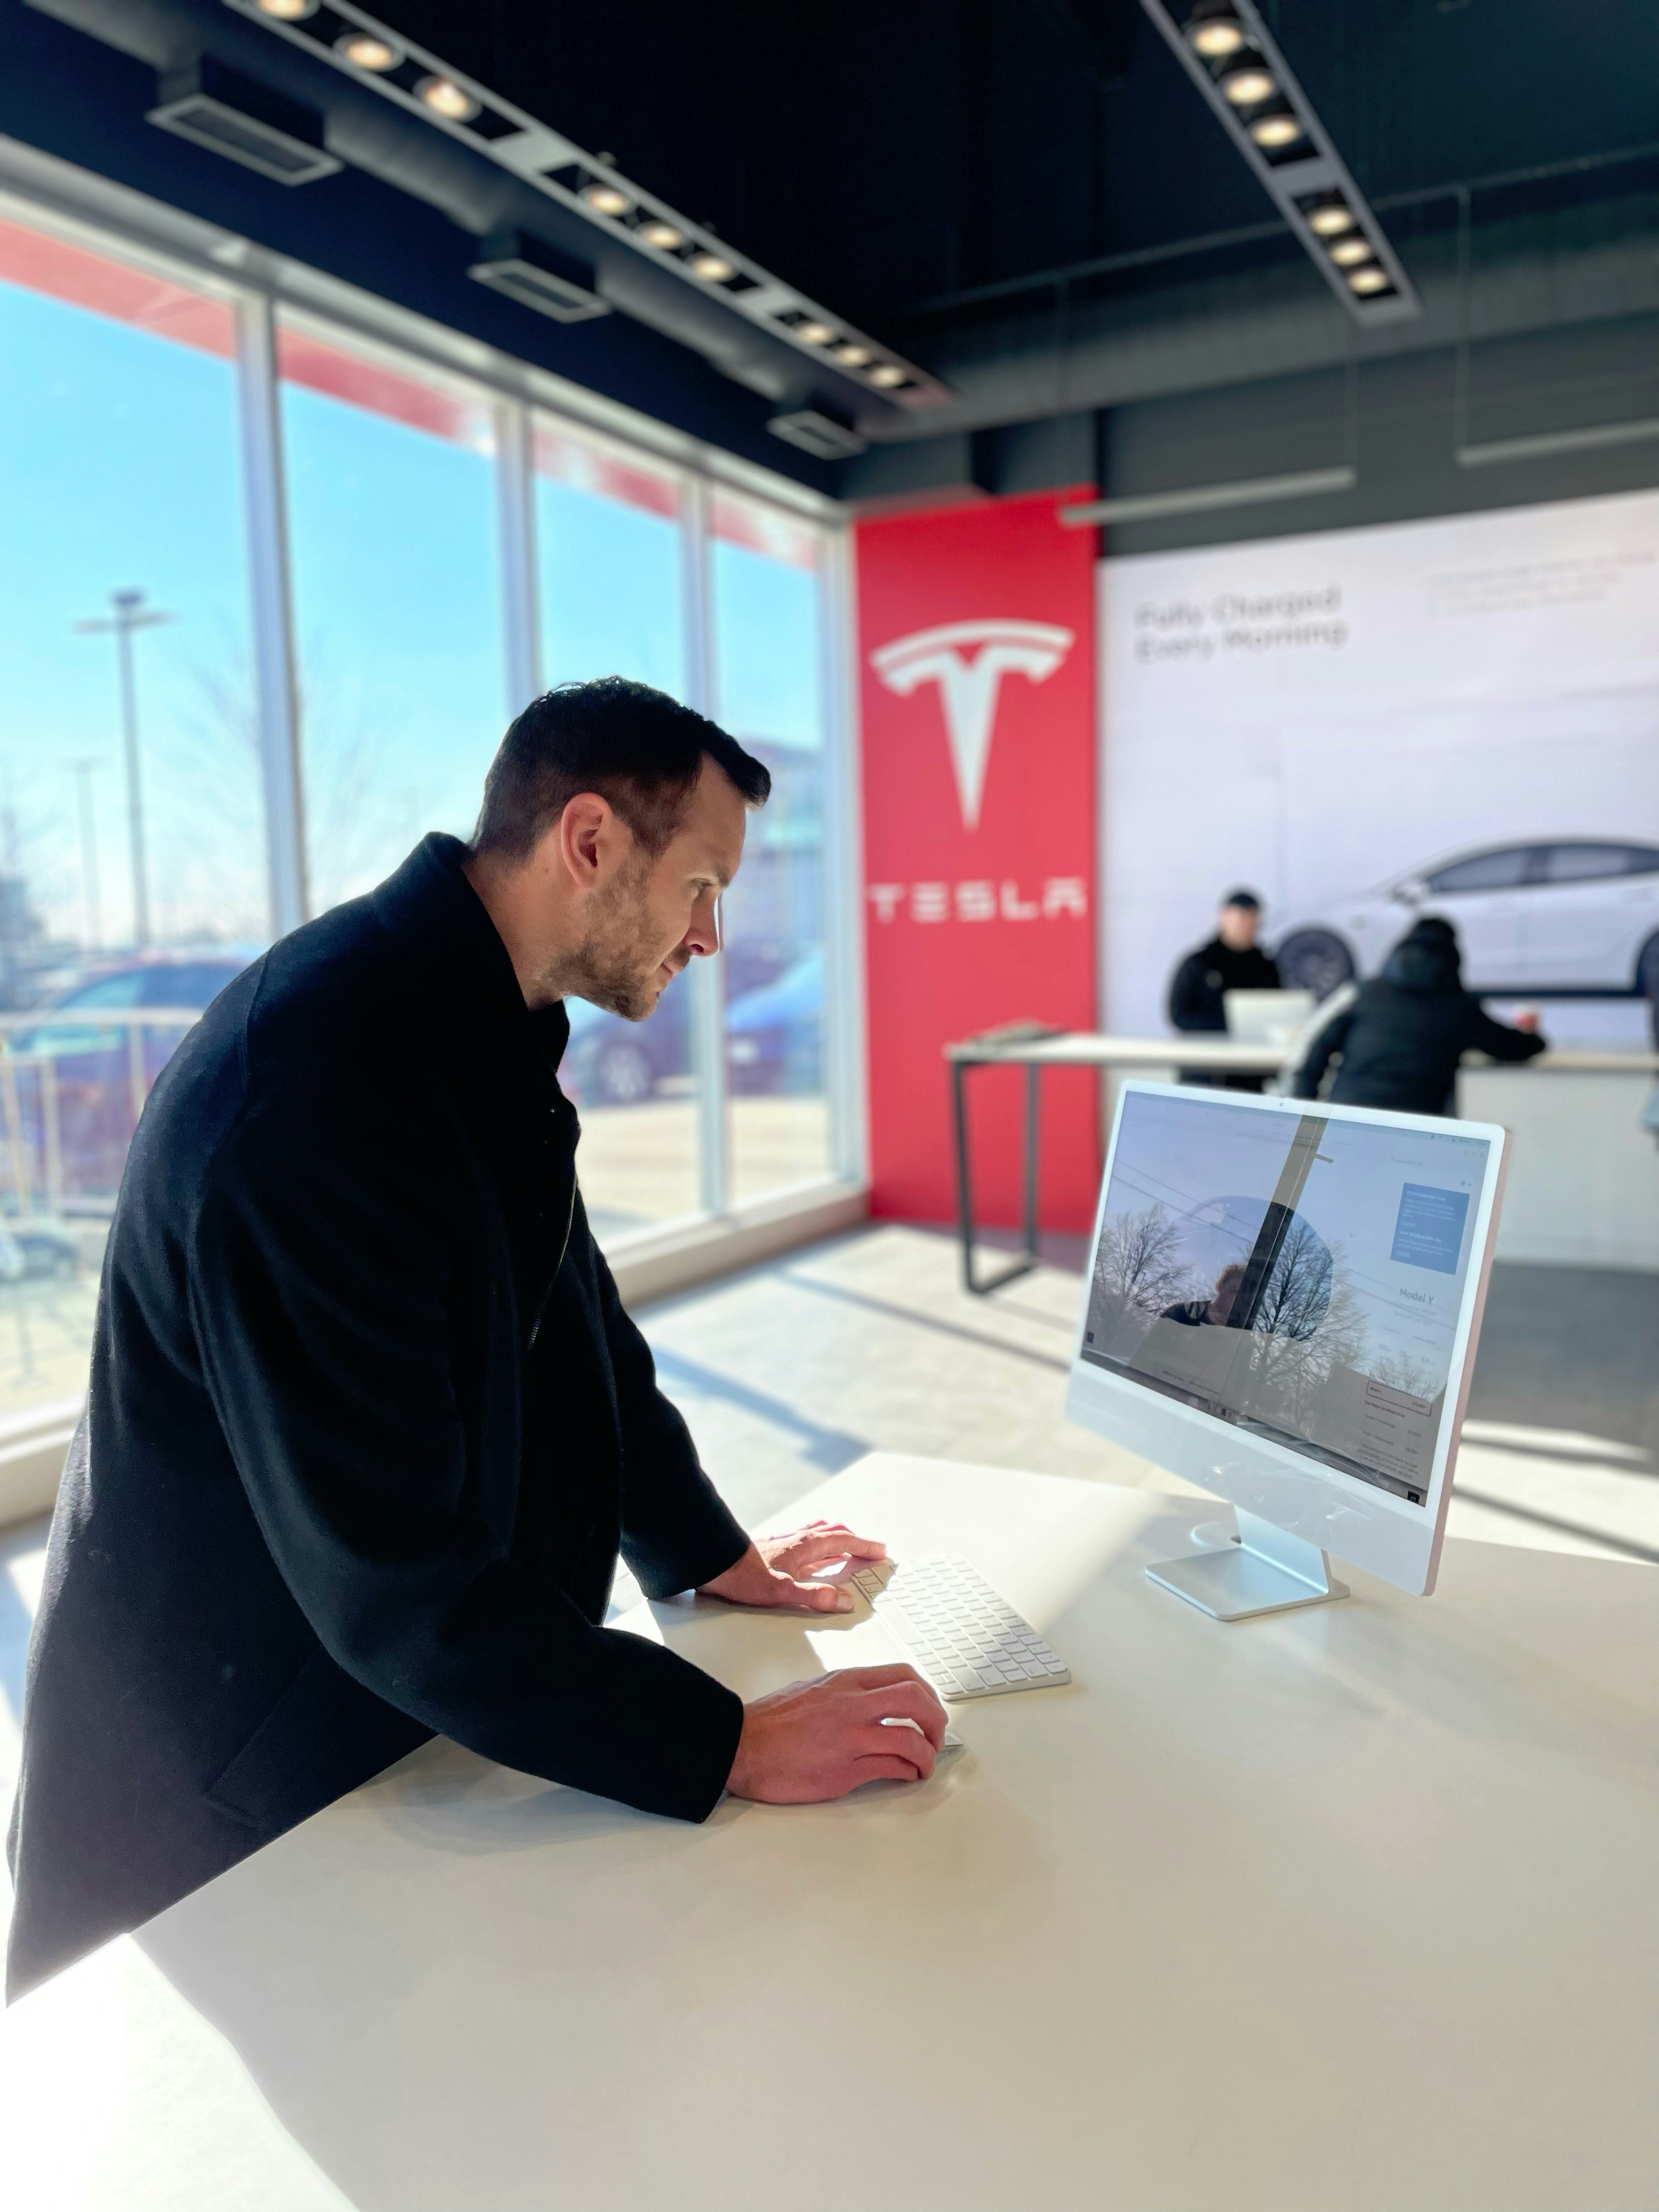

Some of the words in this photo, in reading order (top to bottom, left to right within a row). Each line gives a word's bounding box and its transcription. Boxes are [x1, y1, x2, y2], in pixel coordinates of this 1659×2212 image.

[868, 877, 1087, 925] TESLA
[1400, 1288, 1426, 1303] Model
[1429, 1295, 1435, 1305] Y
